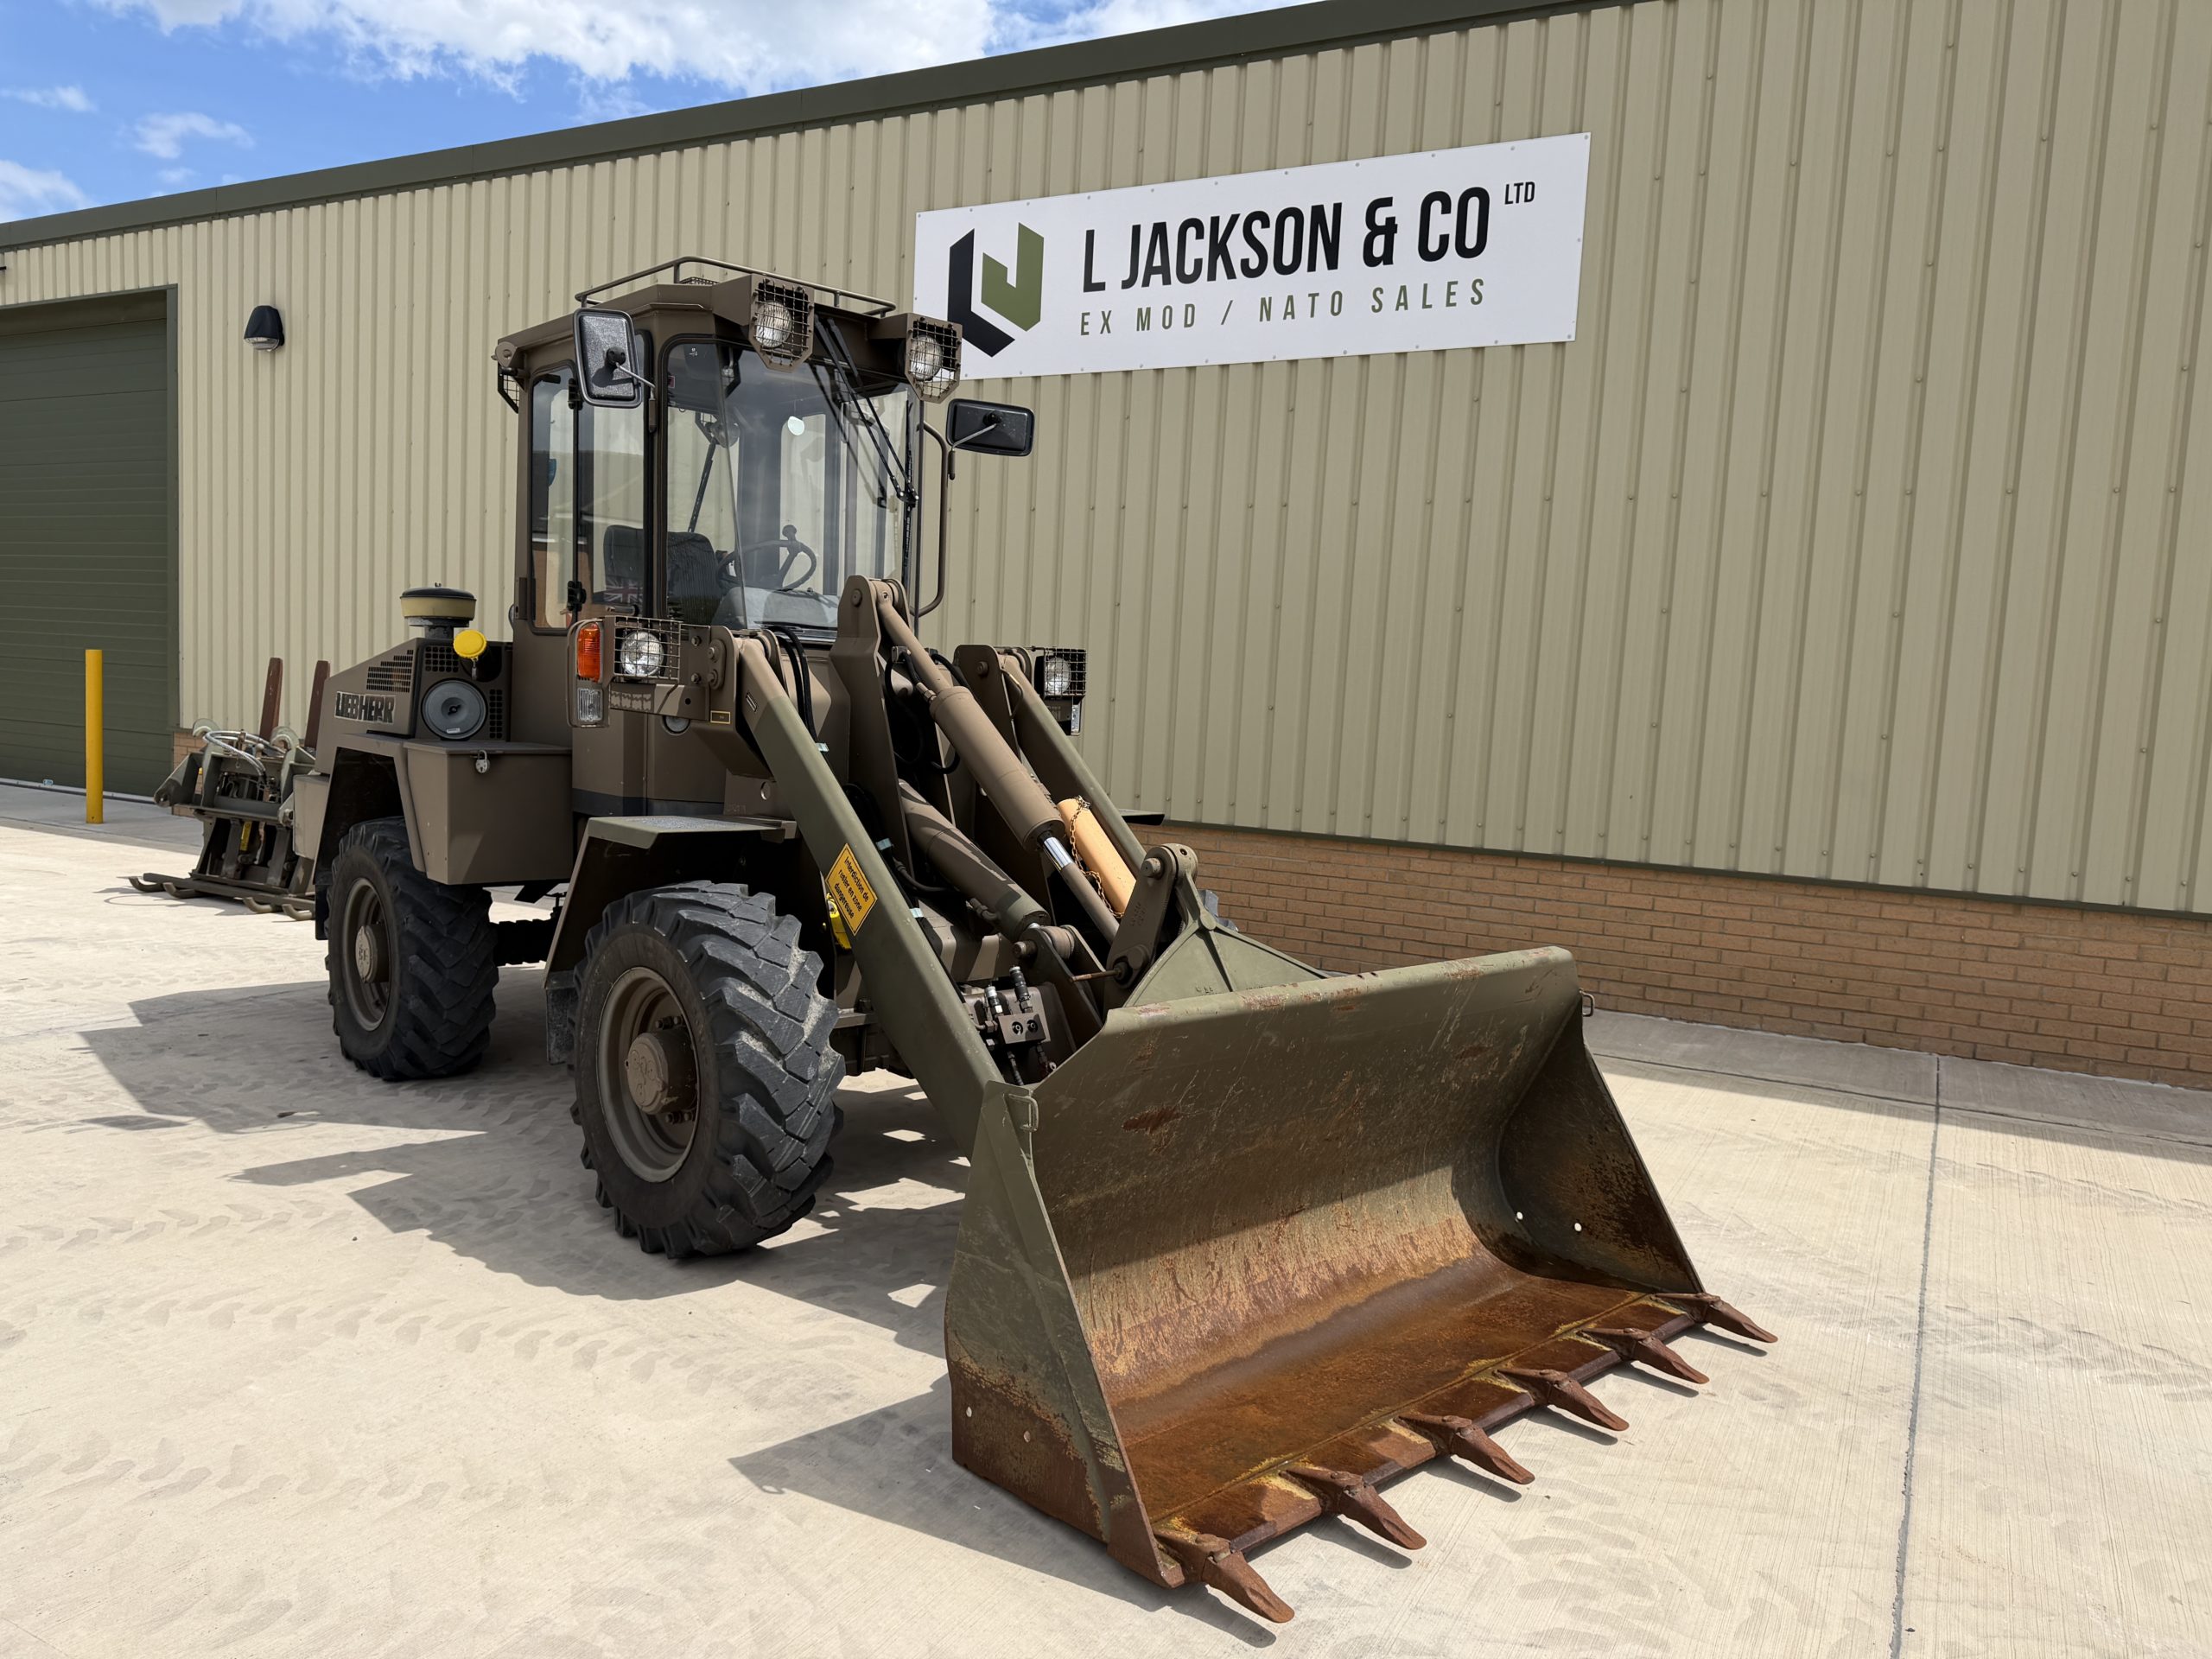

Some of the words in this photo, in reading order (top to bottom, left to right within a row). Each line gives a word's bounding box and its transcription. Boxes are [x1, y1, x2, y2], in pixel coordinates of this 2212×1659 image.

[1083, 229, 1106, 293] L
[1121, 201, 1343, 290] JACKSON
[1362, 196, 1399, 268] &
[1417, 186, 1491, 263] CO
[1503, 181, 1536, 206] LTD
[1080, 309, 1112, 336] EX
[1136, 300, 1196, 332] MOD
[1259, 290, 1343, 322] NATO
[1371, 278, 1484, 314] SALES
[334, 691, 395, 724] LIEBHERR
[844, 856, 864, 893] Interdiction
[834, 883, 855, 918] dangereuse
[852, 895, 862, 912] zone
